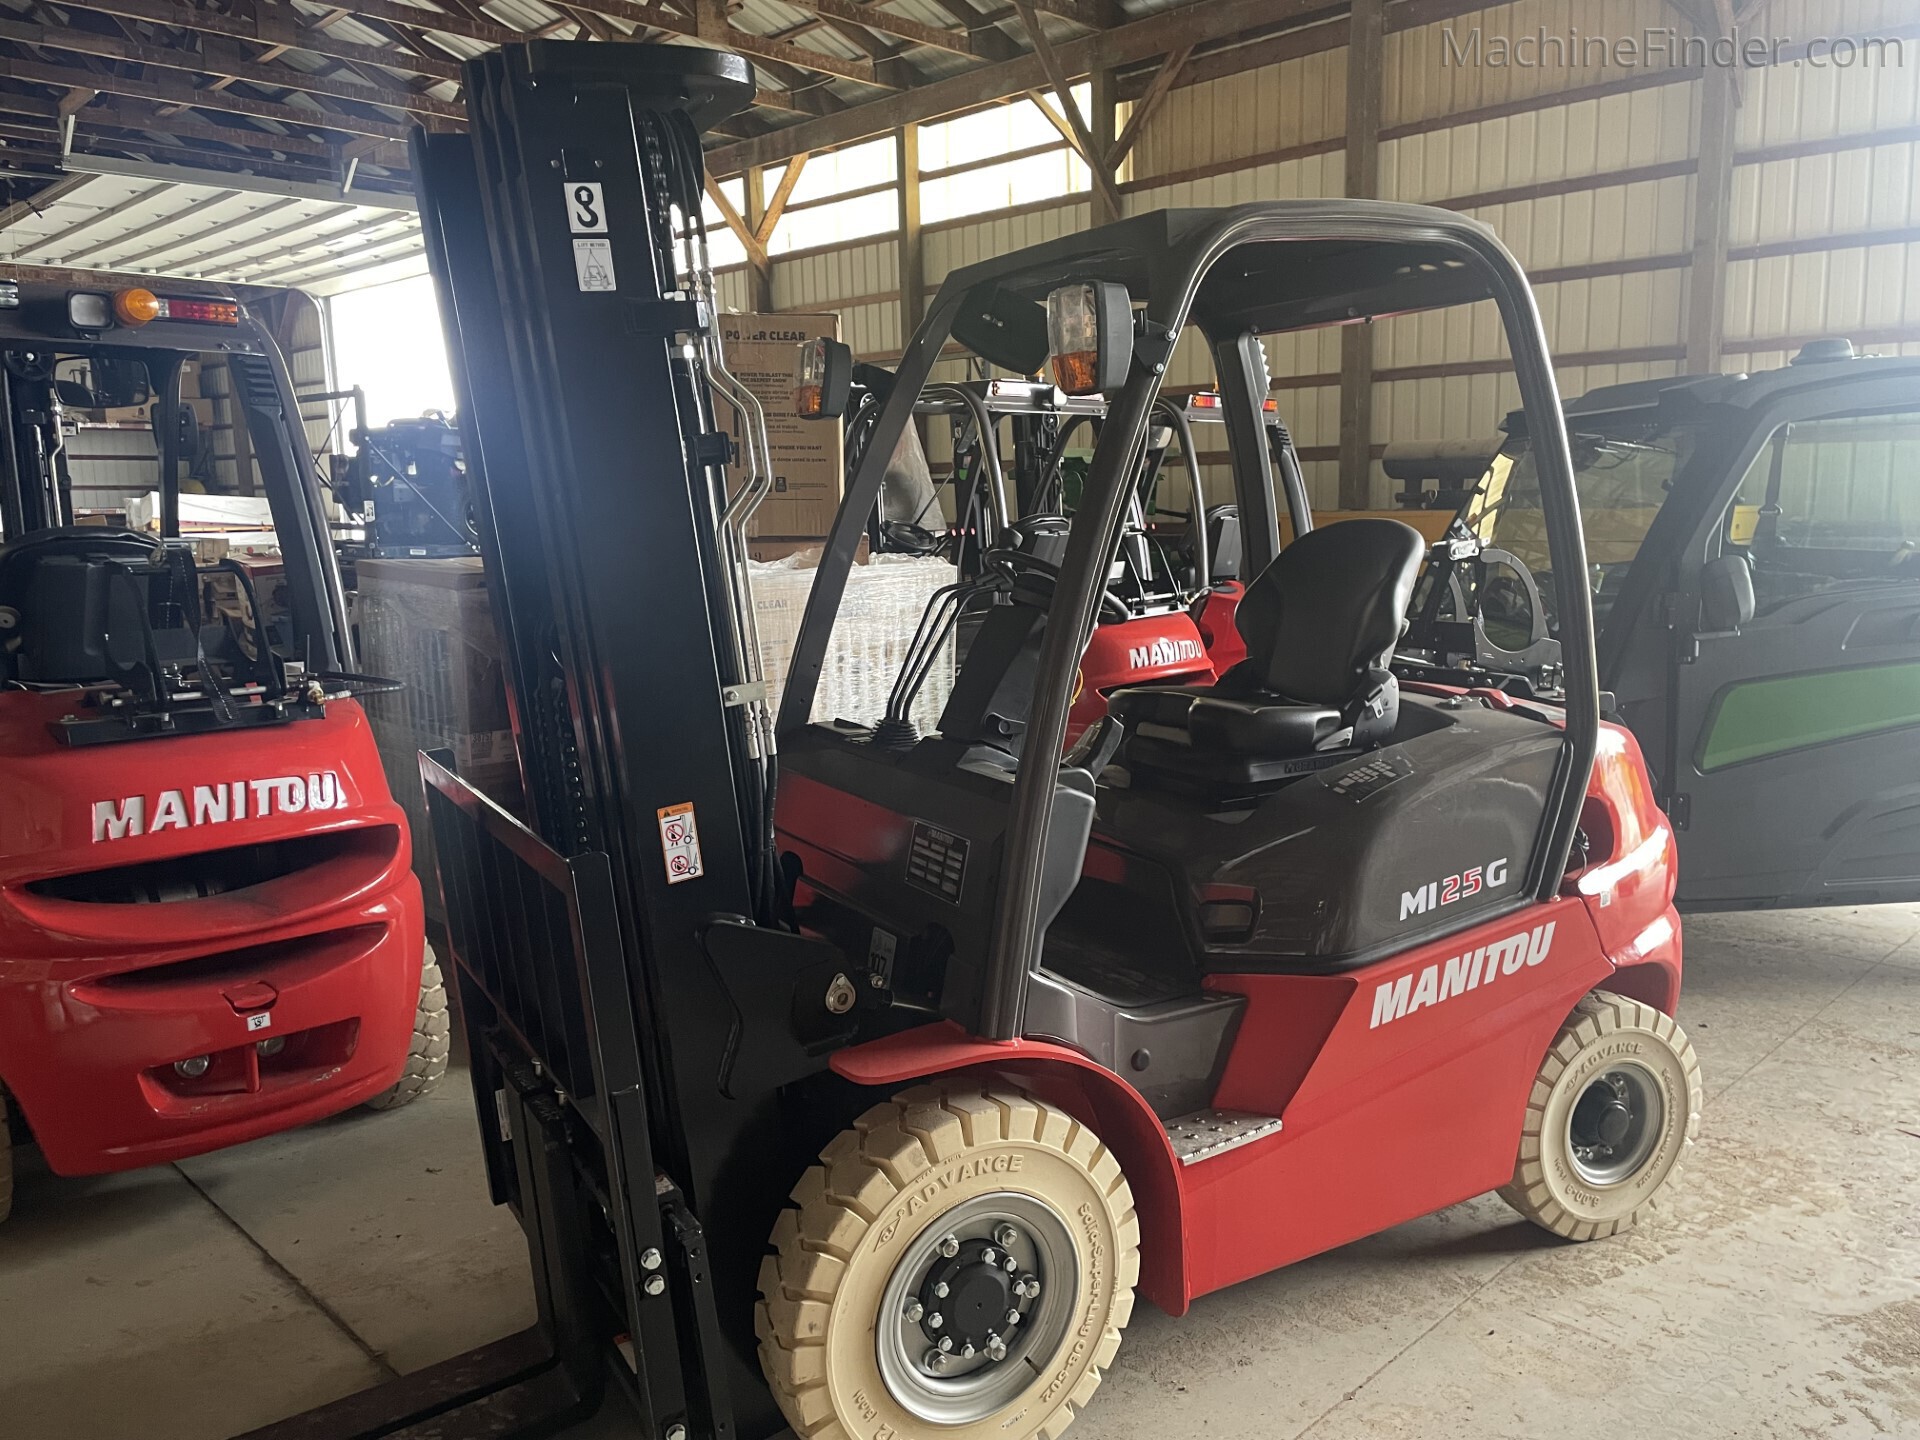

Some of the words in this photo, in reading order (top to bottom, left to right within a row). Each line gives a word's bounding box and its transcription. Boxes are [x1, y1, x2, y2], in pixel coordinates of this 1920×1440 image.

[769, 330, 806, 341] CLEAR
[756, 599, 788, 610] CLEAR
[1128, 638, 1203, 670] MANITOU
[92, 770, 340, 844] MANITOU
[1370, 921, 1557, 1030] MANITOU
[1580, 1042, 1644, 1075] ADVANCE
[907, 1154, 1025, 1217] ADVANCE
